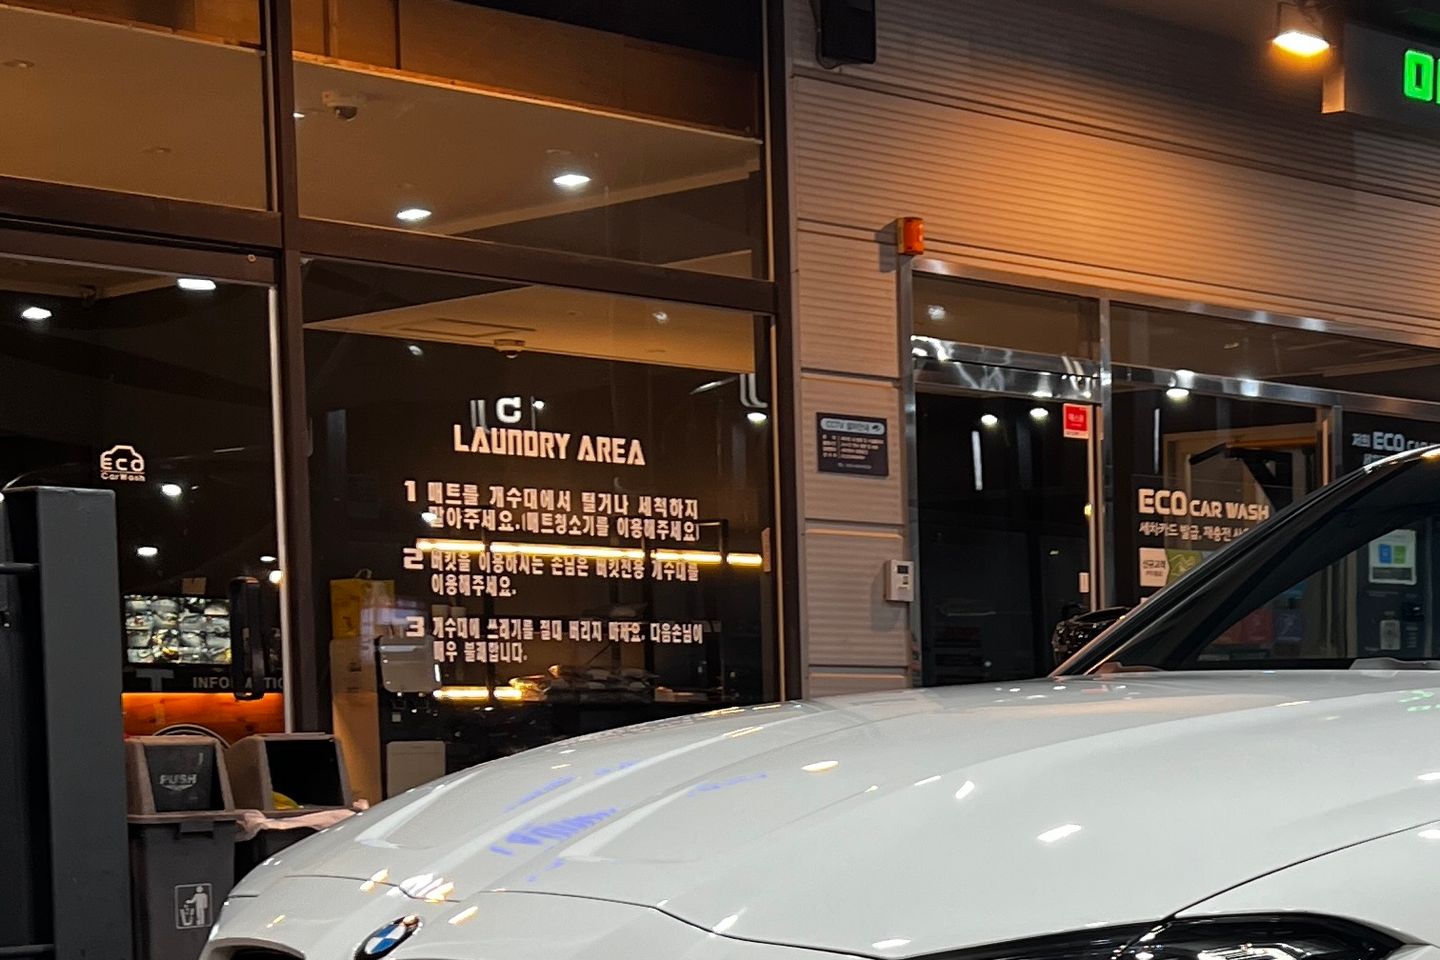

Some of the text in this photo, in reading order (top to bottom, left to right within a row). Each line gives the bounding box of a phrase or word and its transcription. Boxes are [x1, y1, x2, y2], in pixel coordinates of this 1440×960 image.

[453, 424, 646, 466] LAUNDRY AREA
[1372, 431, 1406, 452] ECO
[404, 480, 416, 502] 1
[427, 482, 479, 506] 매트를
[489, 486, 571, 512] 개수대에서
[638, 495, 698, 520] 세척하지
[1137, 488, 1270, 521] ECO CAR WASH
[403, 547, 424, 570] 2
[431, 573, 517, 597] 이용해주세요.
[405, 616, 425, 638] 3
[159, 773, 197, 785] PUSH
